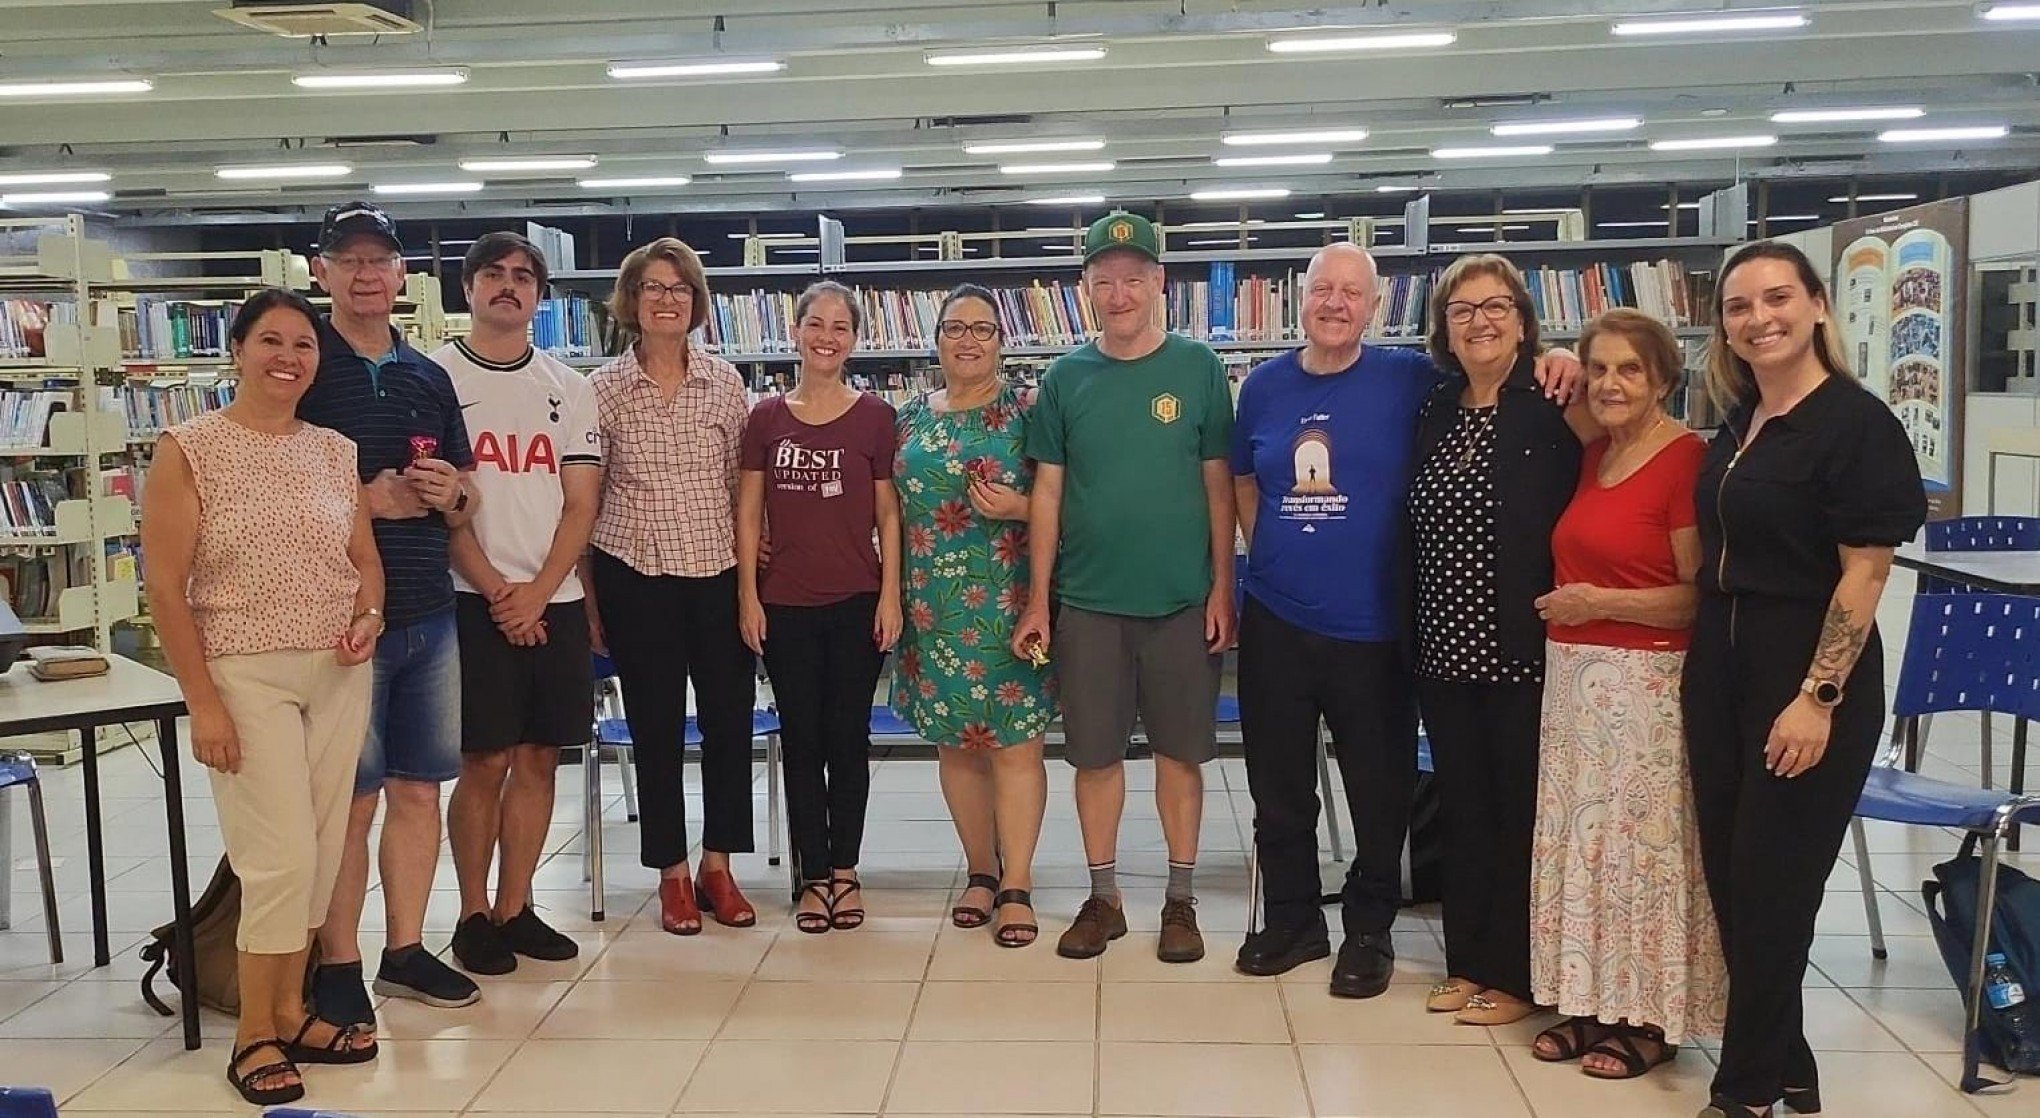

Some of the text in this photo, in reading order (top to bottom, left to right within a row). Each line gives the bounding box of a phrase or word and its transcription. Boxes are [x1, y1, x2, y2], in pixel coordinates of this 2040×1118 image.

[1161, 400, 1173, 415] 15
[471, 430, 557, 474] AIA
[775, 446, 845, 469] BEST
[773, 469, 841, 481] UPDATED
[807, 482, 818, 492] of
